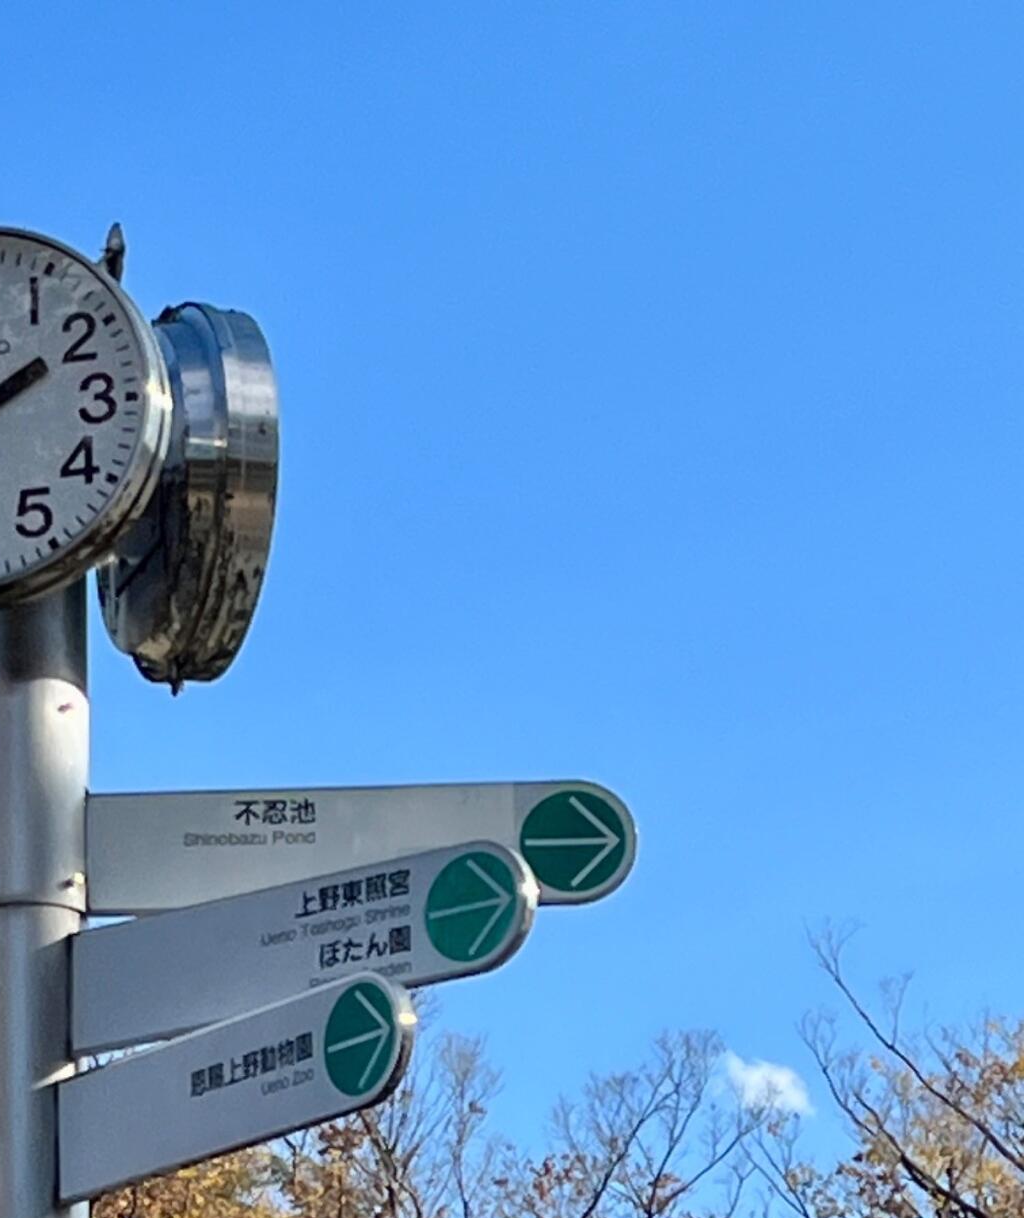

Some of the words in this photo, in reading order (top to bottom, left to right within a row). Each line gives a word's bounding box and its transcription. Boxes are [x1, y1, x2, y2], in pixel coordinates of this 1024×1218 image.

[29, 276, 41, 326] 1
[61, 311, 98, 364] 2
[78, 372, 118, 424] 3
[60, 435, 100, 485] 4
[15, 486, 54, 539] 5
[234, 797, 316, 826] 不忍池
[183, 831, 268, 847] Shinobazu
[272, 830, 316, 844] Pond
[294, 869, 410, 919] 上野東照宮
[260, 929, 297, 946] Ueno
[364, 903, 411, 925] Shrine
[190, 1031, 314, 1098] 恩賜上野動物園
[260, 1076, 290, 1097] Ueno
[292, 1067, 314, 1087] Zoo
